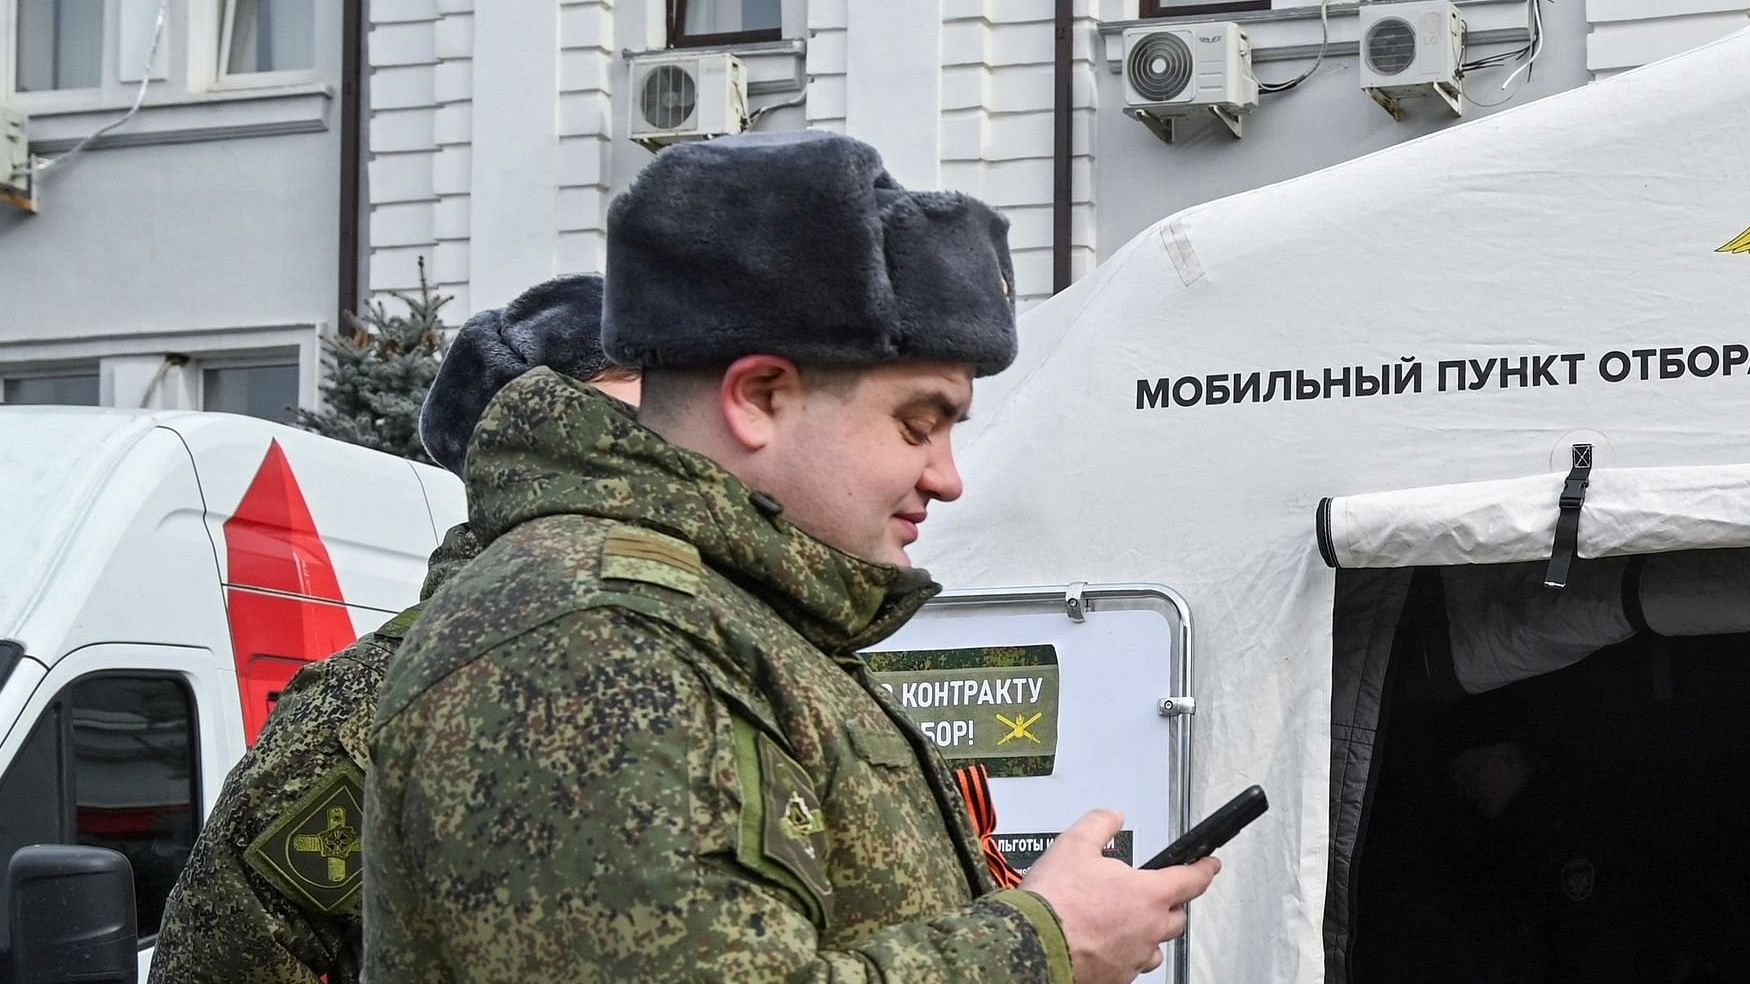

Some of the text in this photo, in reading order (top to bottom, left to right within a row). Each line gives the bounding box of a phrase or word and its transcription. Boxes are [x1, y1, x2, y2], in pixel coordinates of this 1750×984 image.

[1135, 356, 1424, 410] МОБИЛЬНЫЙ
[1437, 352, 1586, 393] ПУНКТ
[902, 677, 1043, 708] КОНТРАКТУ
[916, 719, 974, 747] БОР!
